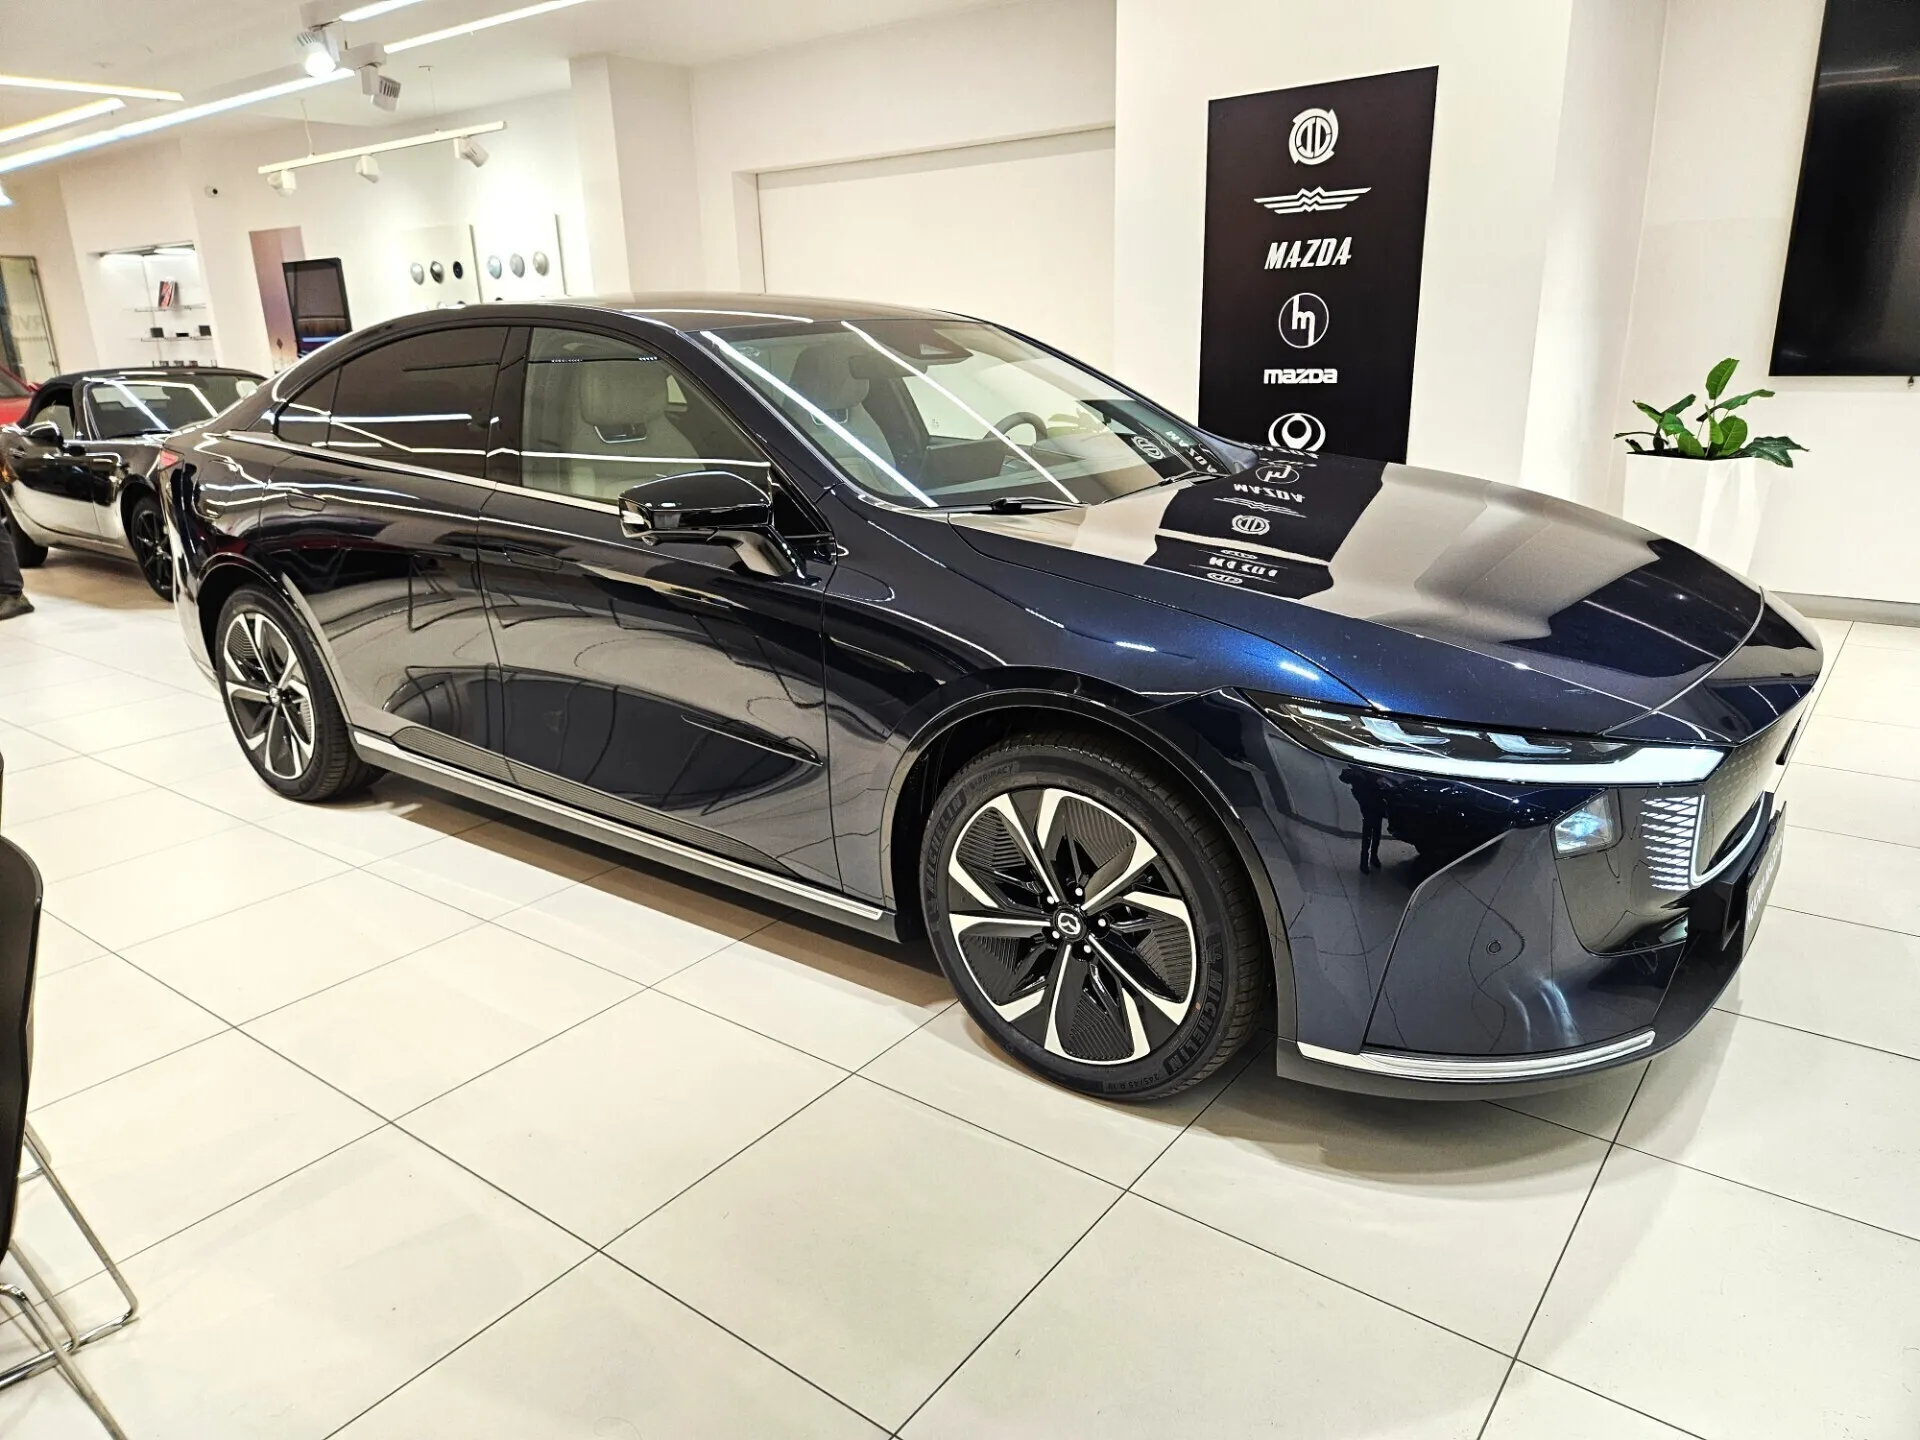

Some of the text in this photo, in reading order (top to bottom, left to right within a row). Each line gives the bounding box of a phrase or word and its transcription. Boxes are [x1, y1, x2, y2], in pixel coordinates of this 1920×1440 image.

[1264, 237, 1352, 269] MAZDA
[1264, 369, 1337, 384] mazda
[926, 794, 964, 895] MICHELIN
[1169, 970, 1222, 1071] MICHELIN
